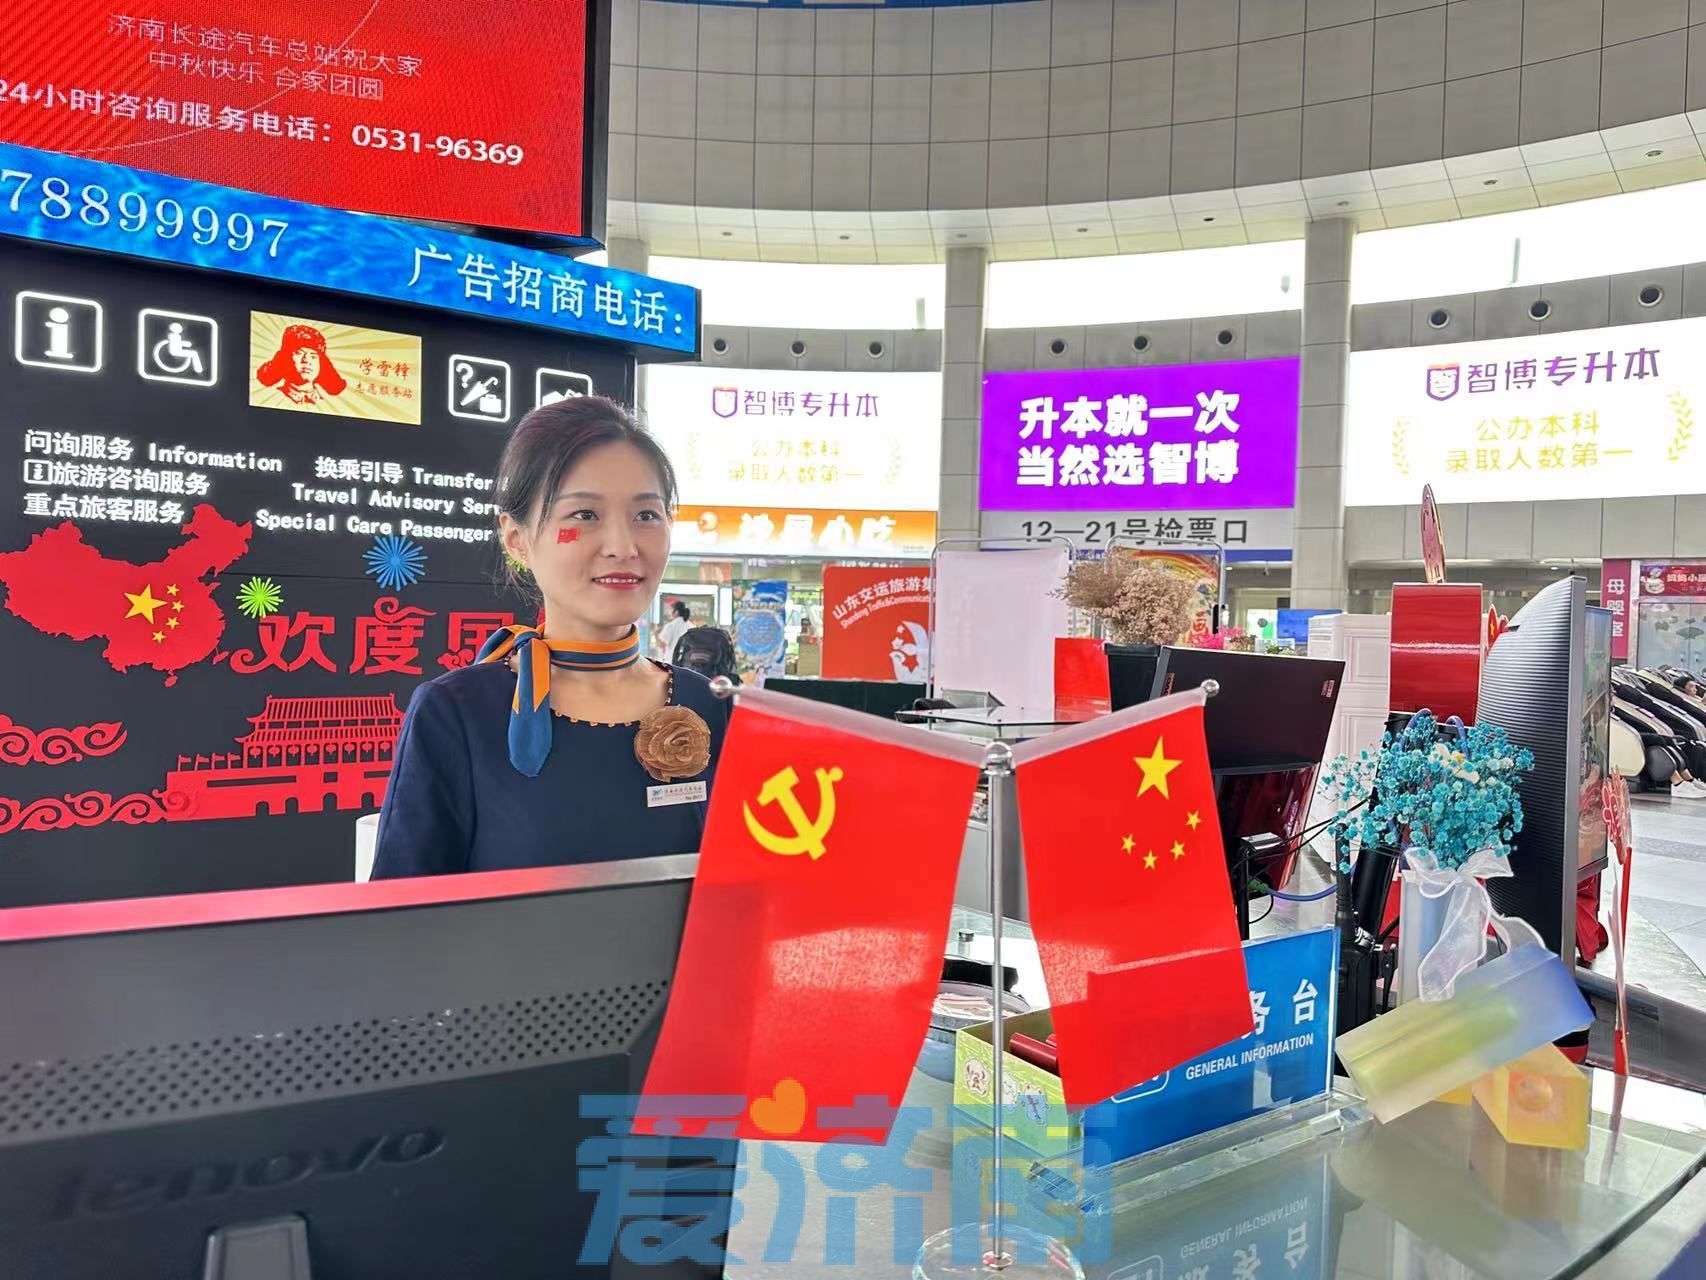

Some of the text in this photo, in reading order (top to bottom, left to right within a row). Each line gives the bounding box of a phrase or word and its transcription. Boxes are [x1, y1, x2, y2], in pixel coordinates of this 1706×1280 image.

[108, 12, 423, 78] 济南长途汽车总站祝大家
[149, 50, 384, 101] 中秋快乐 合家团圆
[351, 124, 524, 166] 0531-96369
[1, 168, 289, 257] 78899997
[1467, 347, 1661, 394] 智博专升本
[744, 390, 879, 418] 智博专升本
[1019, 390, 1240, 439] 升本就一次
[1475, 409, 1600, 442] 公办本科
[24, 429, 283, 472] 问询服务 Information
[1017, 439, 1240, 487] 当然选智博
[1445, 442, 1633, 474] 录取人数第一
[52, 461, 210, 496] 旅游咨询服务
[315, 455, 494, 491] 换乘引导 Transfer
[24, 492, 185, 524] 重点旅客服务
[292, 482, 358, 505] Travel
[368, 489, 455, 515] Advisory
[256, 508, 493, 543] Special Care Passenger
[230, 596, 546, 675] 欢度国
[1186, 1032, 1314, 1080] GENERAL INFORMATION
